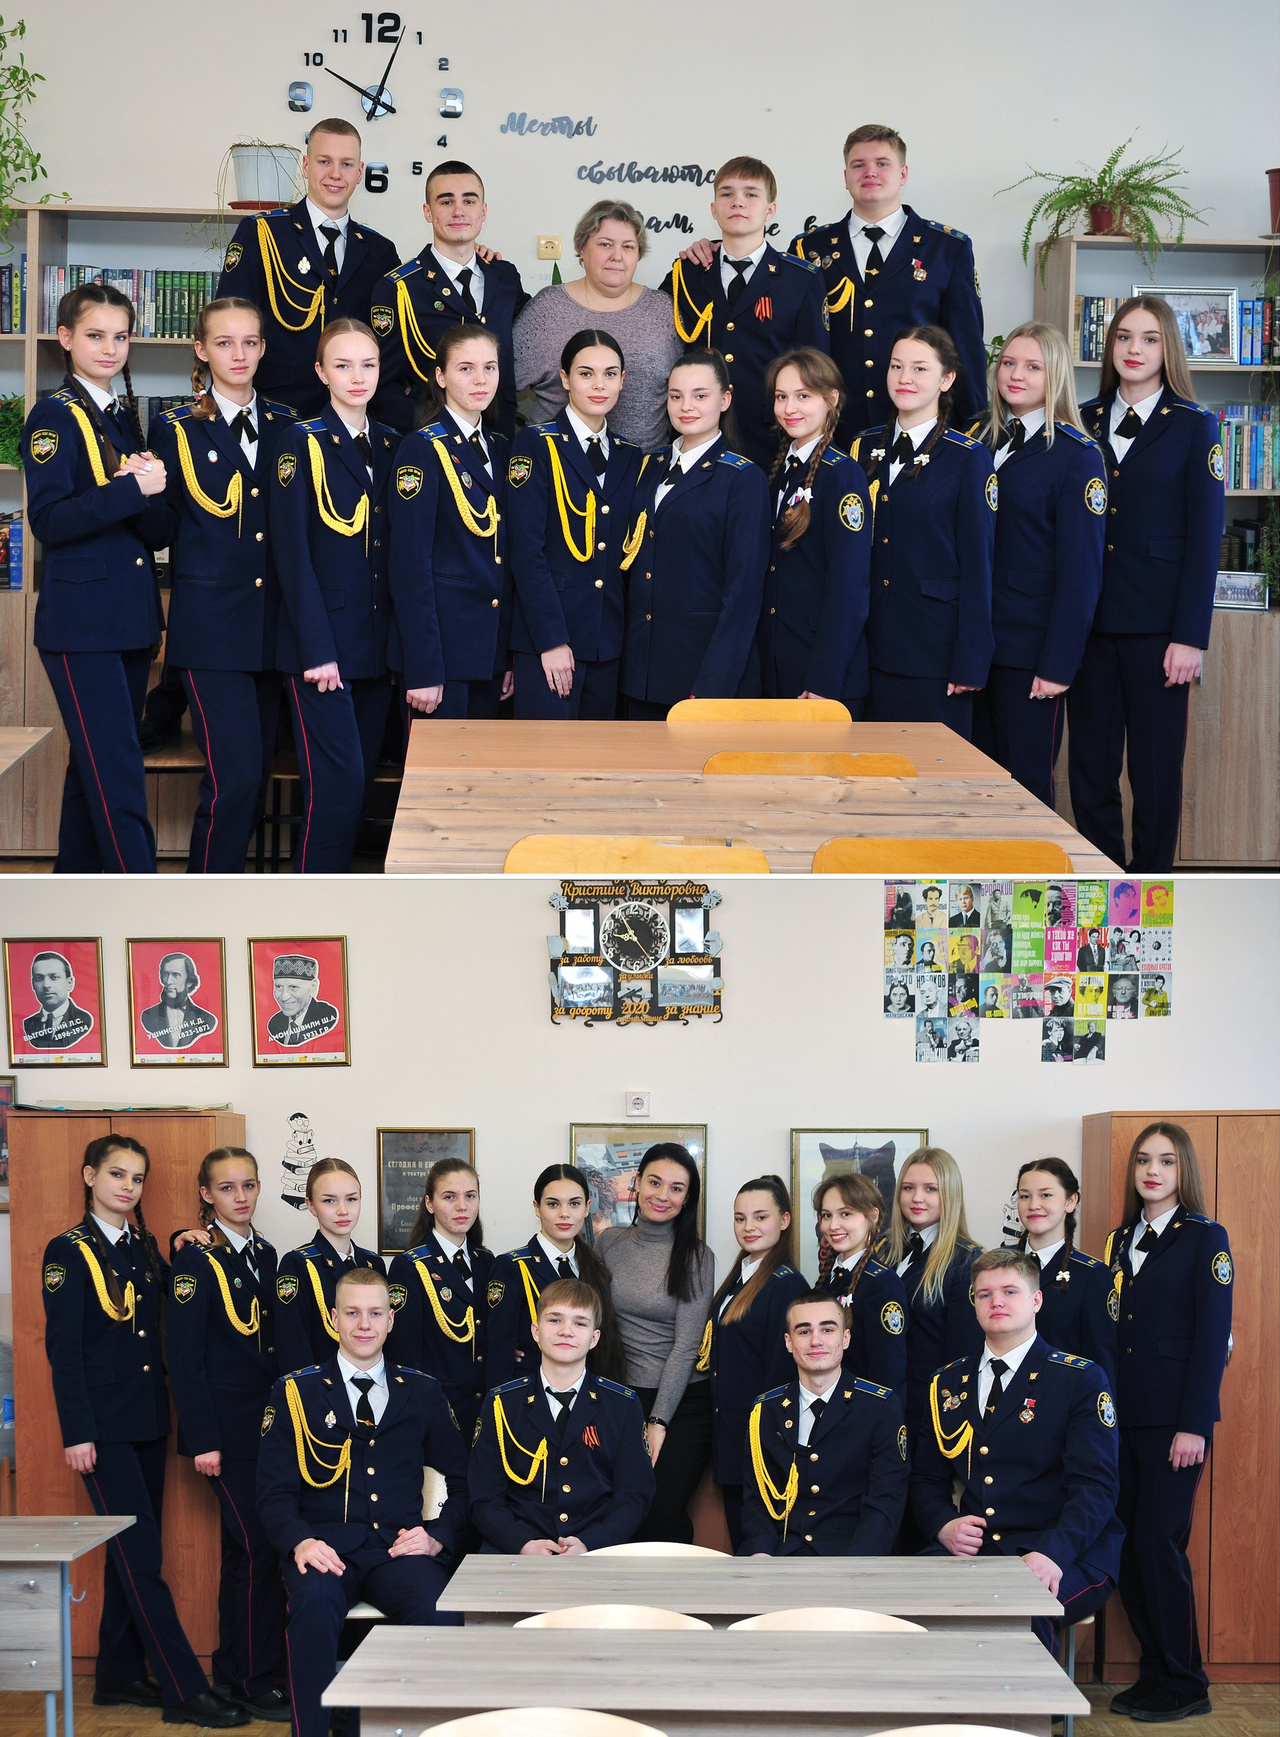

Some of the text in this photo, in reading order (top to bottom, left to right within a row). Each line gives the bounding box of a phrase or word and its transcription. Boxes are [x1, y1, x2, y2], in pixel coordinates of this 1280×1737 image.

[361, 12, 401, 43] 12
[333, 29, 348, 43] 11
[416, 31, 423, 45] 1
[303, 52, 324, 67] 10
[438, 57, 449, 71] 2
[288, 81, 313, 112] 9
[439, 87, 464, 119] 3
[500, 112, 597, 139] Мечты
[437, 134, 448, 148] 4
[412, 161, 423, 176] 5
[577, 160, 715, 187] сбываютс
[364, 161, 389, 193] 6
[561, 882, 708, 900] Кристине Викторовне
[602, 933, 608, 944] 9
[661, 931, 668, 943] 3
[607, 947, 614, 959] 8
[559, 954, 604, 968] за заботу
[633, 960, 640, 972] 6
[664, 956, 675, 968] за
[553, 1005, 613, 1020] за доброту
[622, 1002, 650, 1015] 2020
[663, 1004, 721, 1020] за знание
[23, 1021, 68, 1042] ВЫГОТСКИЙ
[54, 1025, 89, 1041] 1896-1934
[146, 1020, 189, 1040] УШИНСКИЙ
[177, 1024, 211, 1040] 1823-1871
[268, 1019, 321, 1042] АМОНАШВИЛИ
[302, 1030, 319, 1040] 1931
[388, 1160, 417, 1168] СЕГОДНЯ
